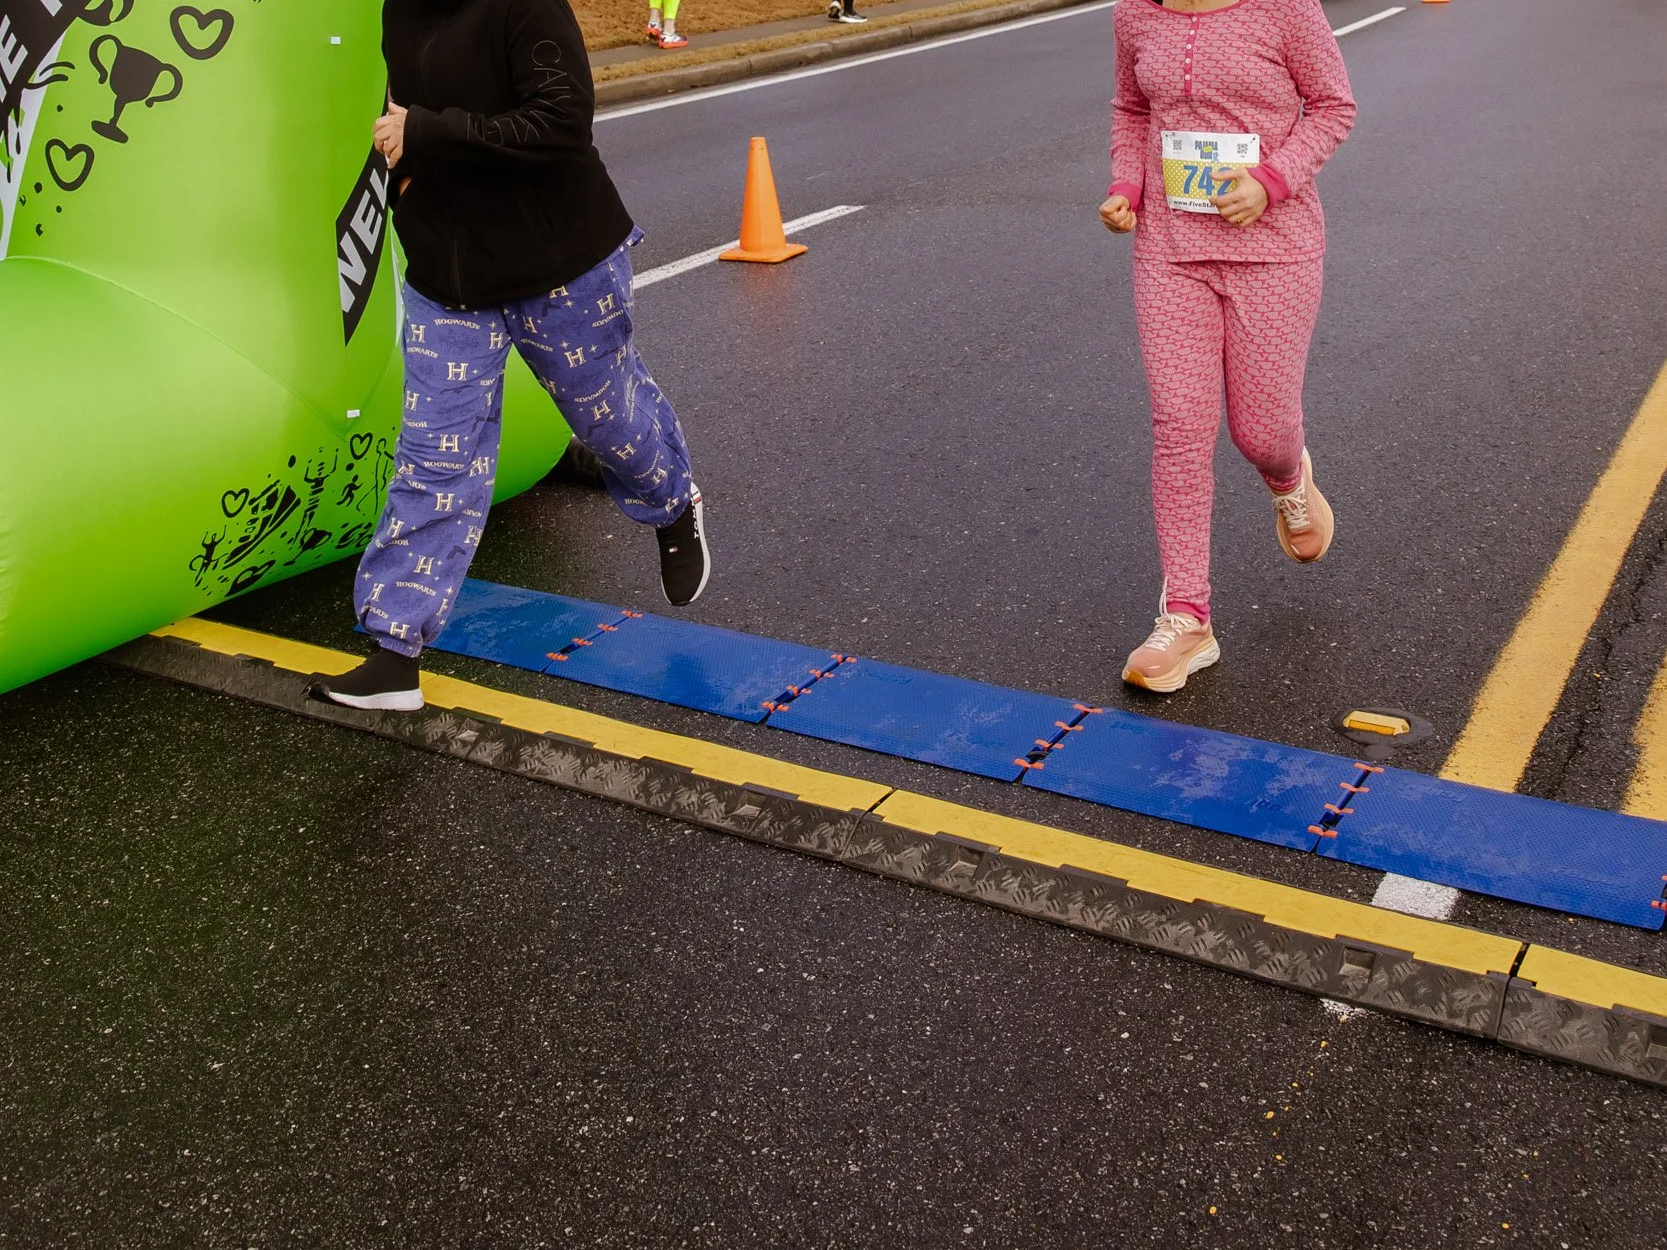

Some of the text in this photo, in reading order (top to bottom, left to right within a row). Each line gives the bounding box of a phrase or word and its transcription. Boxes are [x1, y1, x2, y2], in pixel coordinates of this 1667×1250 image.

[1183, 165, 1234, 196] 742
[597, 293, 616, 316] H
[411, 324, 426, 343] H
[434, 318, 481, 330] HOGWARTS
[489, 332, 504, 349] H
[564, 347, 587, 368] H
[447, 362, 469, 381] H
[405, 391, 420, 411] H
[591, 399, 612, 421] H
[438, 434, 460, 452] H
[615, 441, 638, 461] H
[434, 493, 455, 512] H
[387, 517, 405, 538] H
[413, 555, 435, 575] H
[396, 581, 437, 597] HOGWARTS
[390, 621, 410, 639] H
